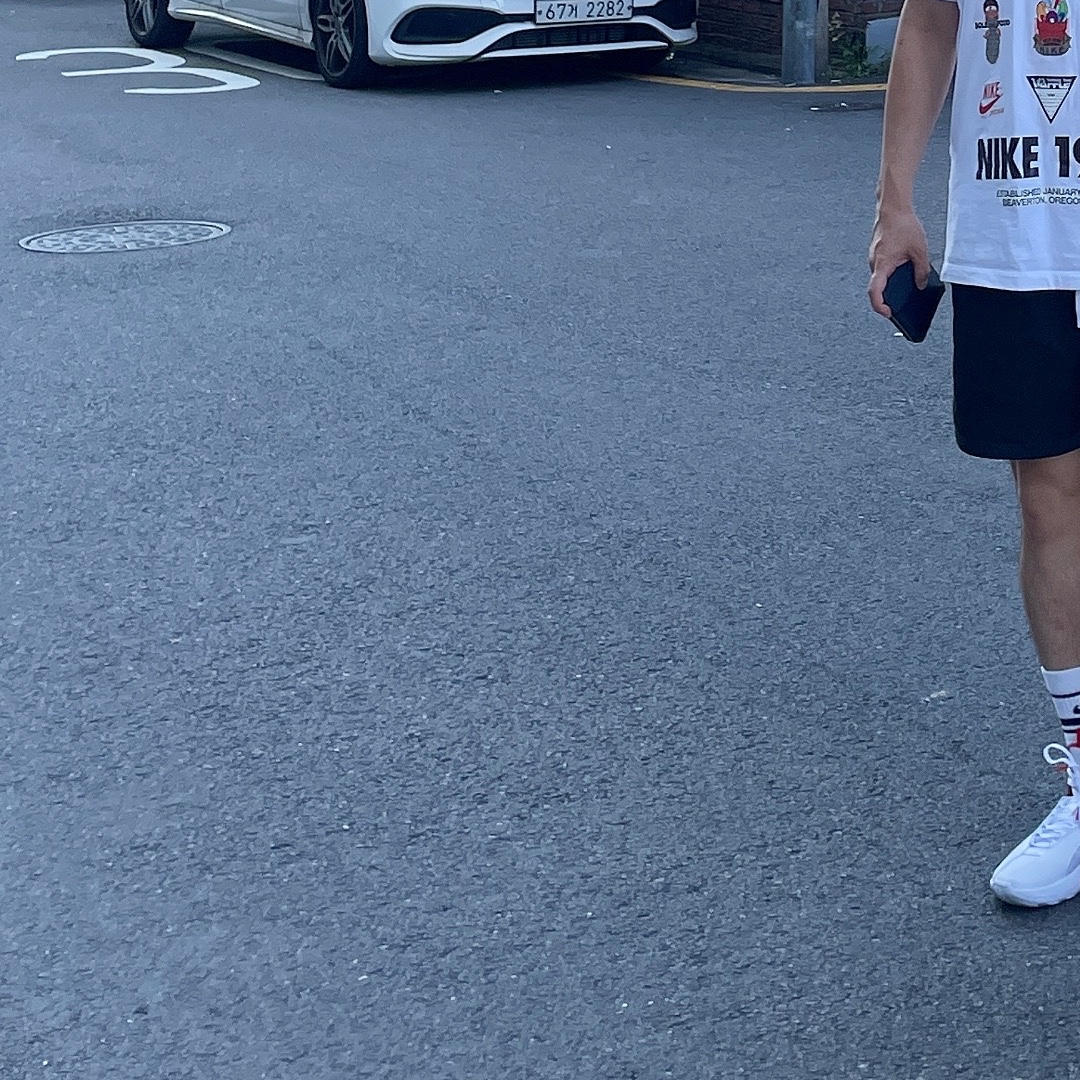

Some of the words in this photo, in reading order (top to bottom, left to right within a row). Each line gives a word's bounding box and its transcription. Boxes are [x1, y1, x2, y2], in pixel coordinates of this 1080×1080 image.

[546, 3, 578, 20] 67거
[586, 0, 624, 18] 2282
[976, 136, 1039, 180] NIKE
[996, 187, 1041, 198] ESTABLISHED
